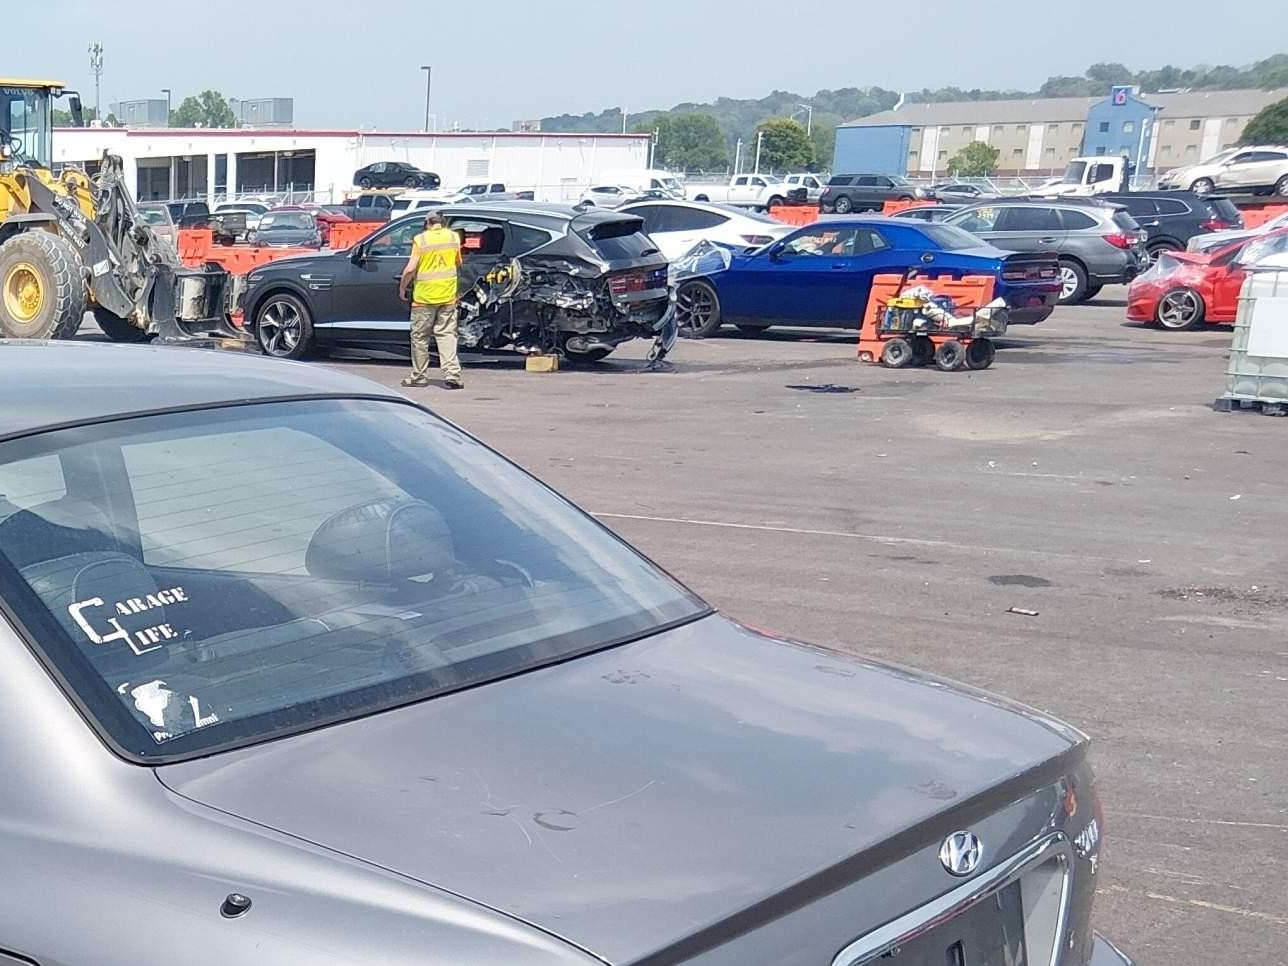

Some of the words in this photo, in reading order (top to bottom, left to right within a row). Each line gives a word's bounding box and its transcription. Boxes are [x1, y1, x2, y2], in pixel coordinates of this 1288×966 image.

[2, 87, 35, 98] VOLVO
[1114, 89, 1127, 105] 6
[68, 586, 189, 644] GARAGE
[115, 621, 179, 656] LIFE
